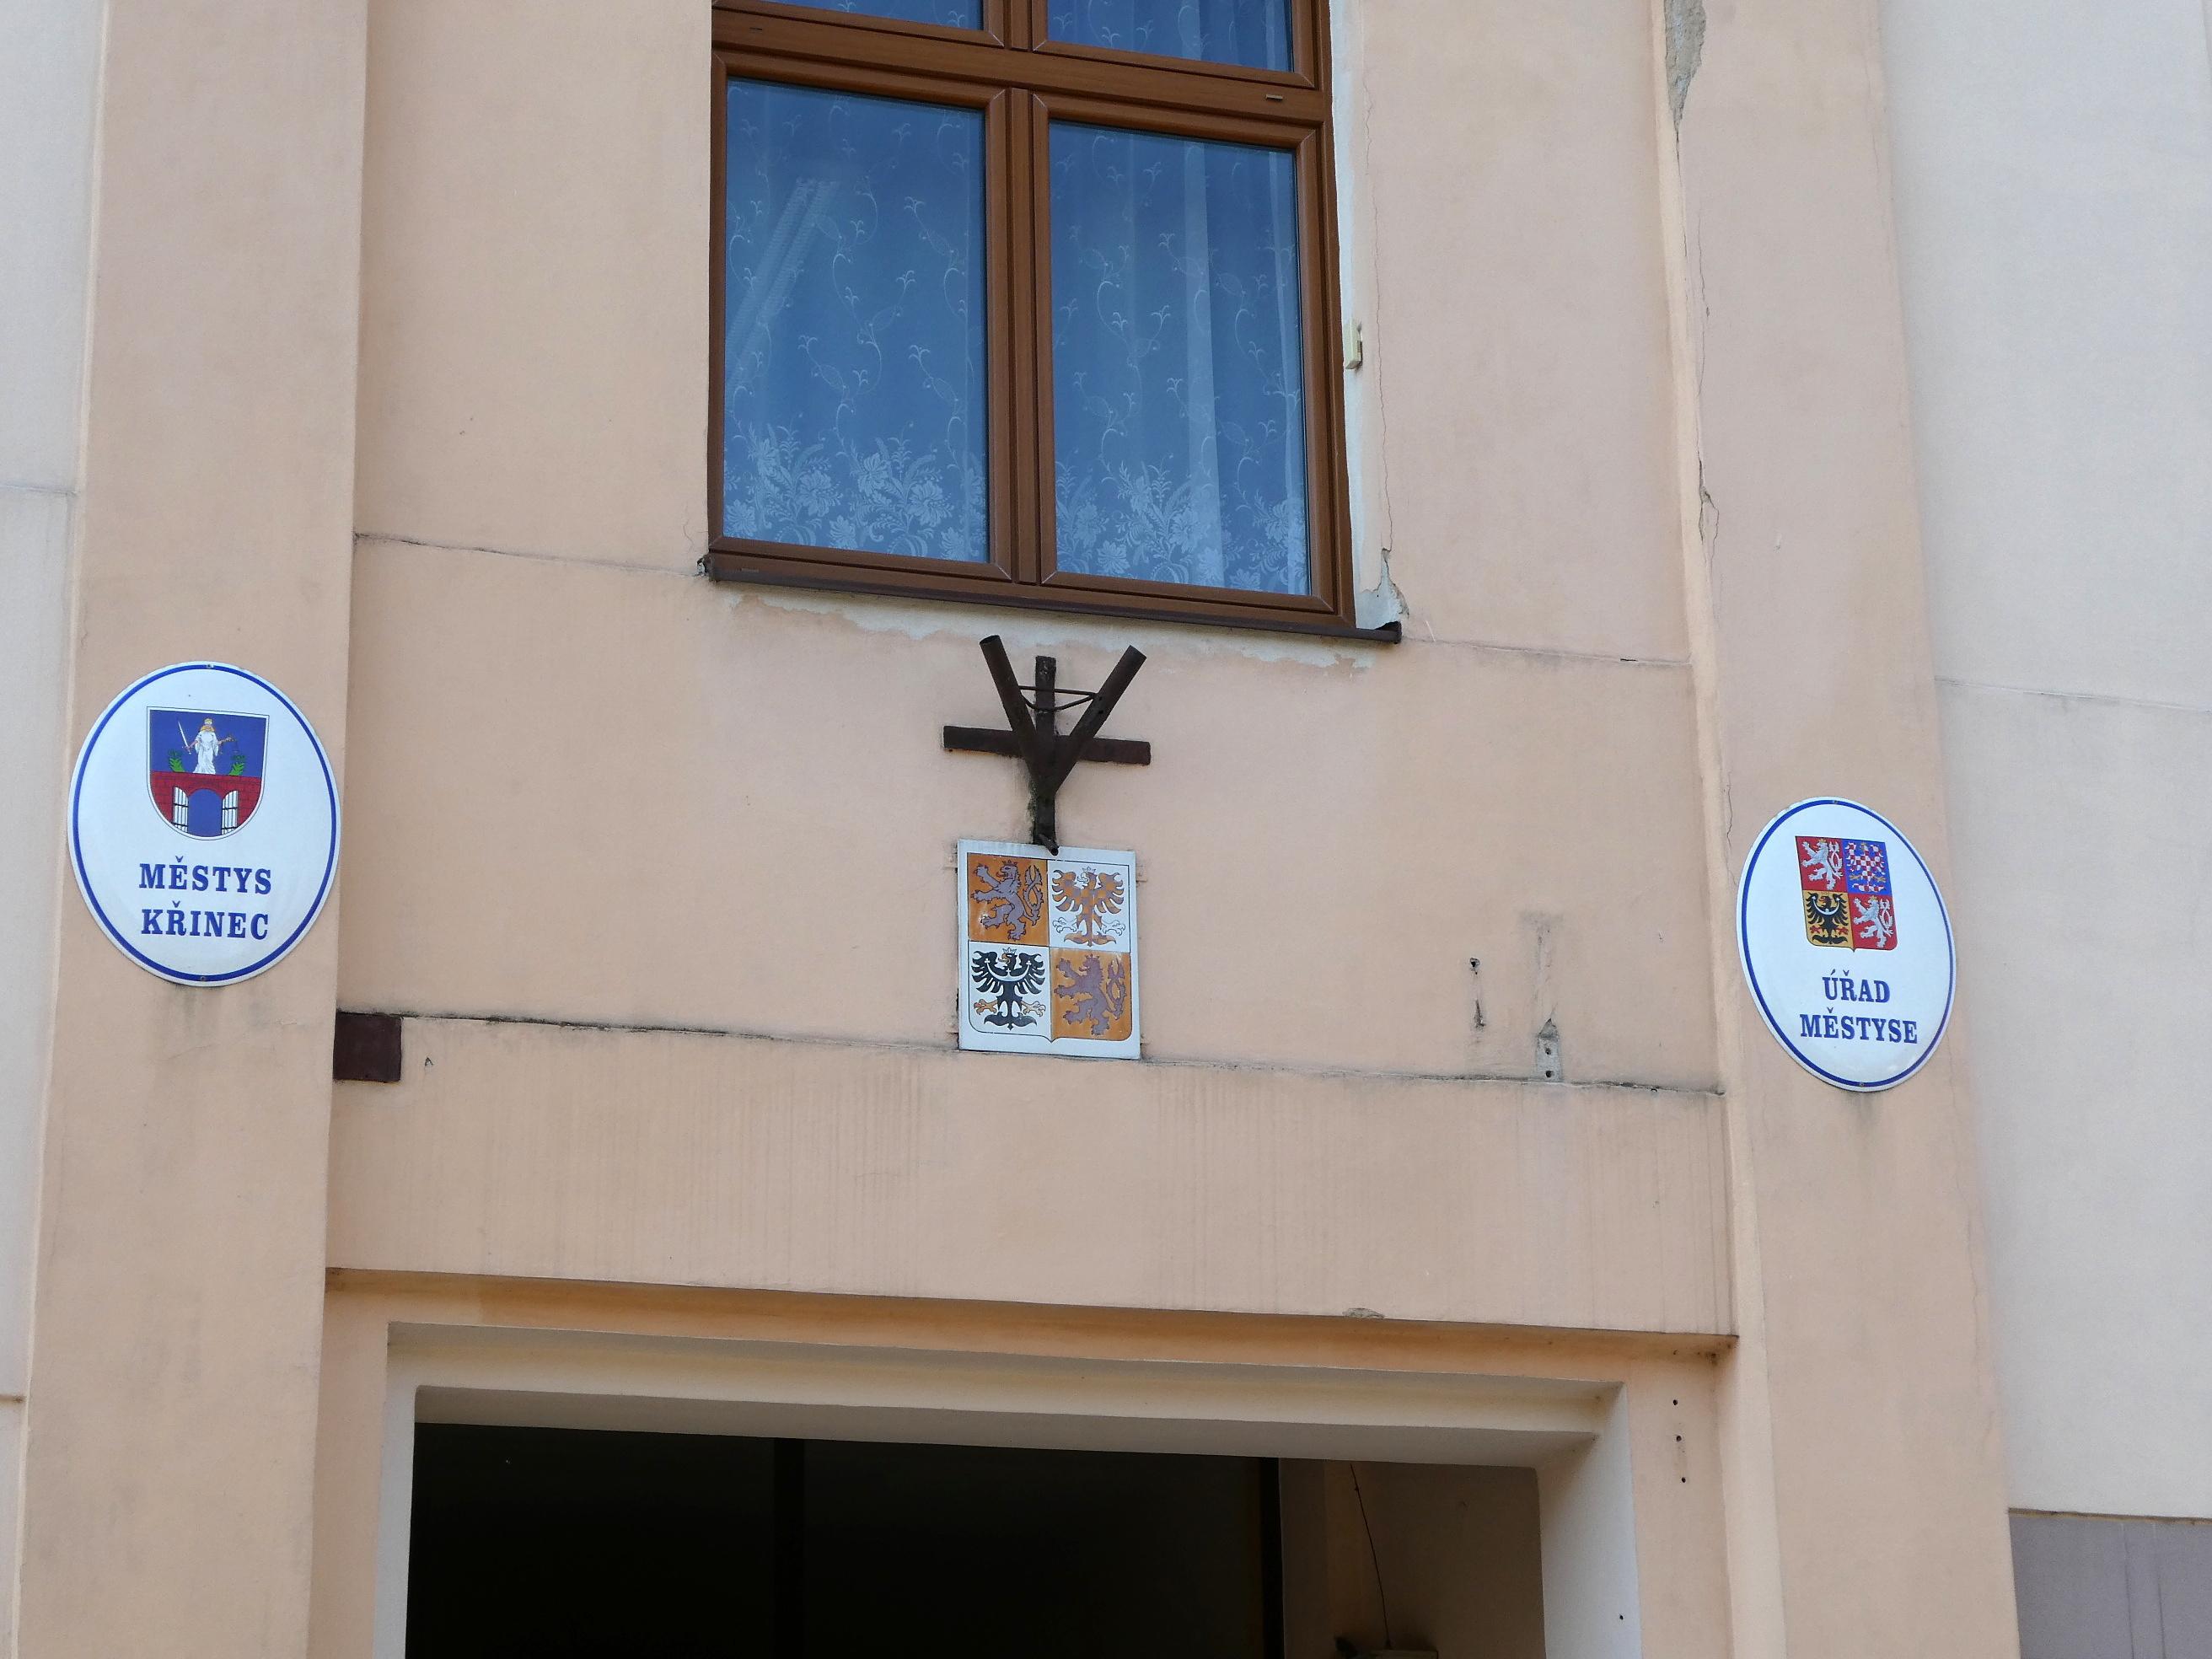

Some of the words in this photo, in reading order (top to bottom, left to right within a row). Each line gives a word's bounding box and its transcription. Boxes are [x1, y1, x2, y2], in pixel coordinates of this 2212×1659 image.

[138, 855, 271, 895] MĚSTYS
[141, 900, 269, 941] KŘINEC
[1822, 969, 1891, 1003] ÚŘAD
[1799, 1007, 1918, 1044] MĚSTYSE
